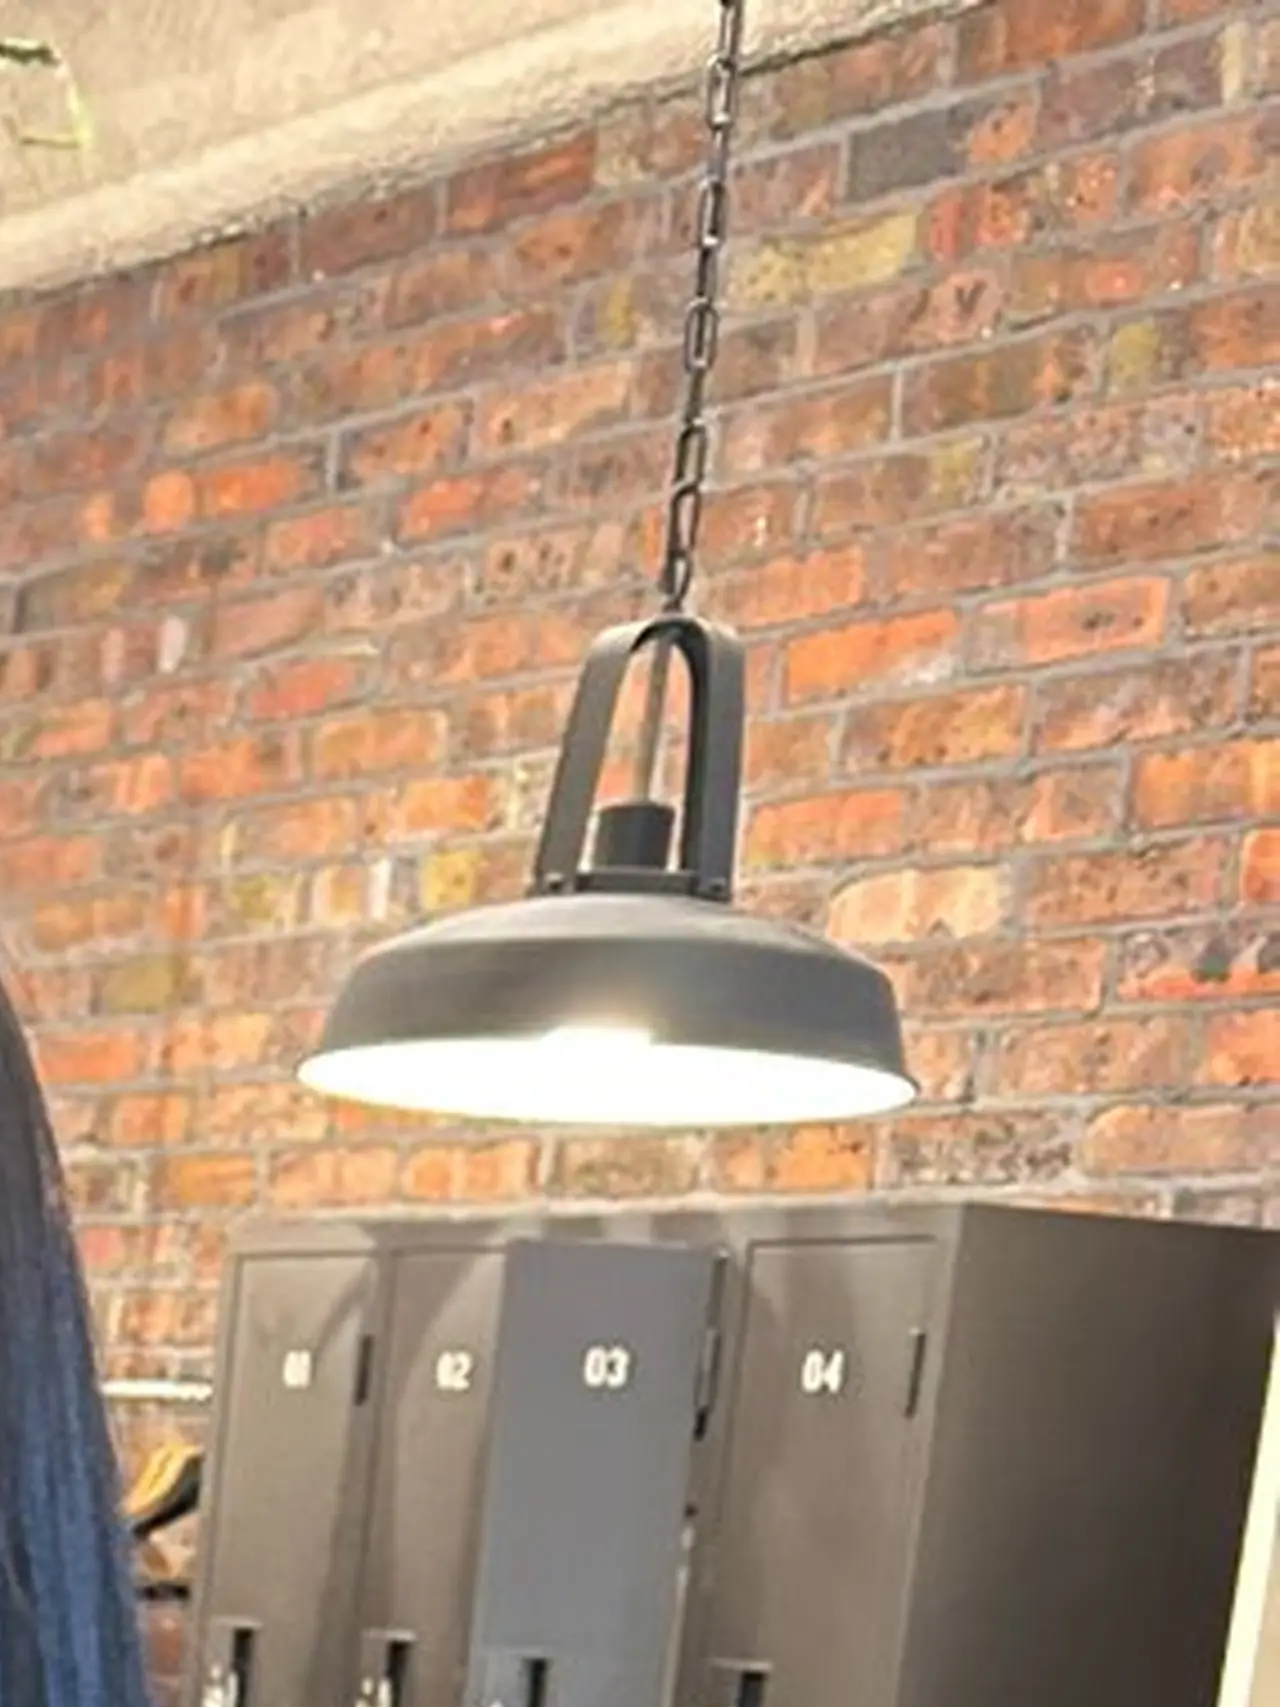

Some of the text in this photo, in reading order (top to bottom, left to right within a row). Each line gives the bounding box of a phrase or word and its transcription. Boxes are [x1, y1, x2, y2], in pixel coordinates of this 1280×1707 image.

[436, 1351, 472, 1391] 02
[584, 1346, 630, 1387] 03
[801, 1349, 844, 1392] 04
